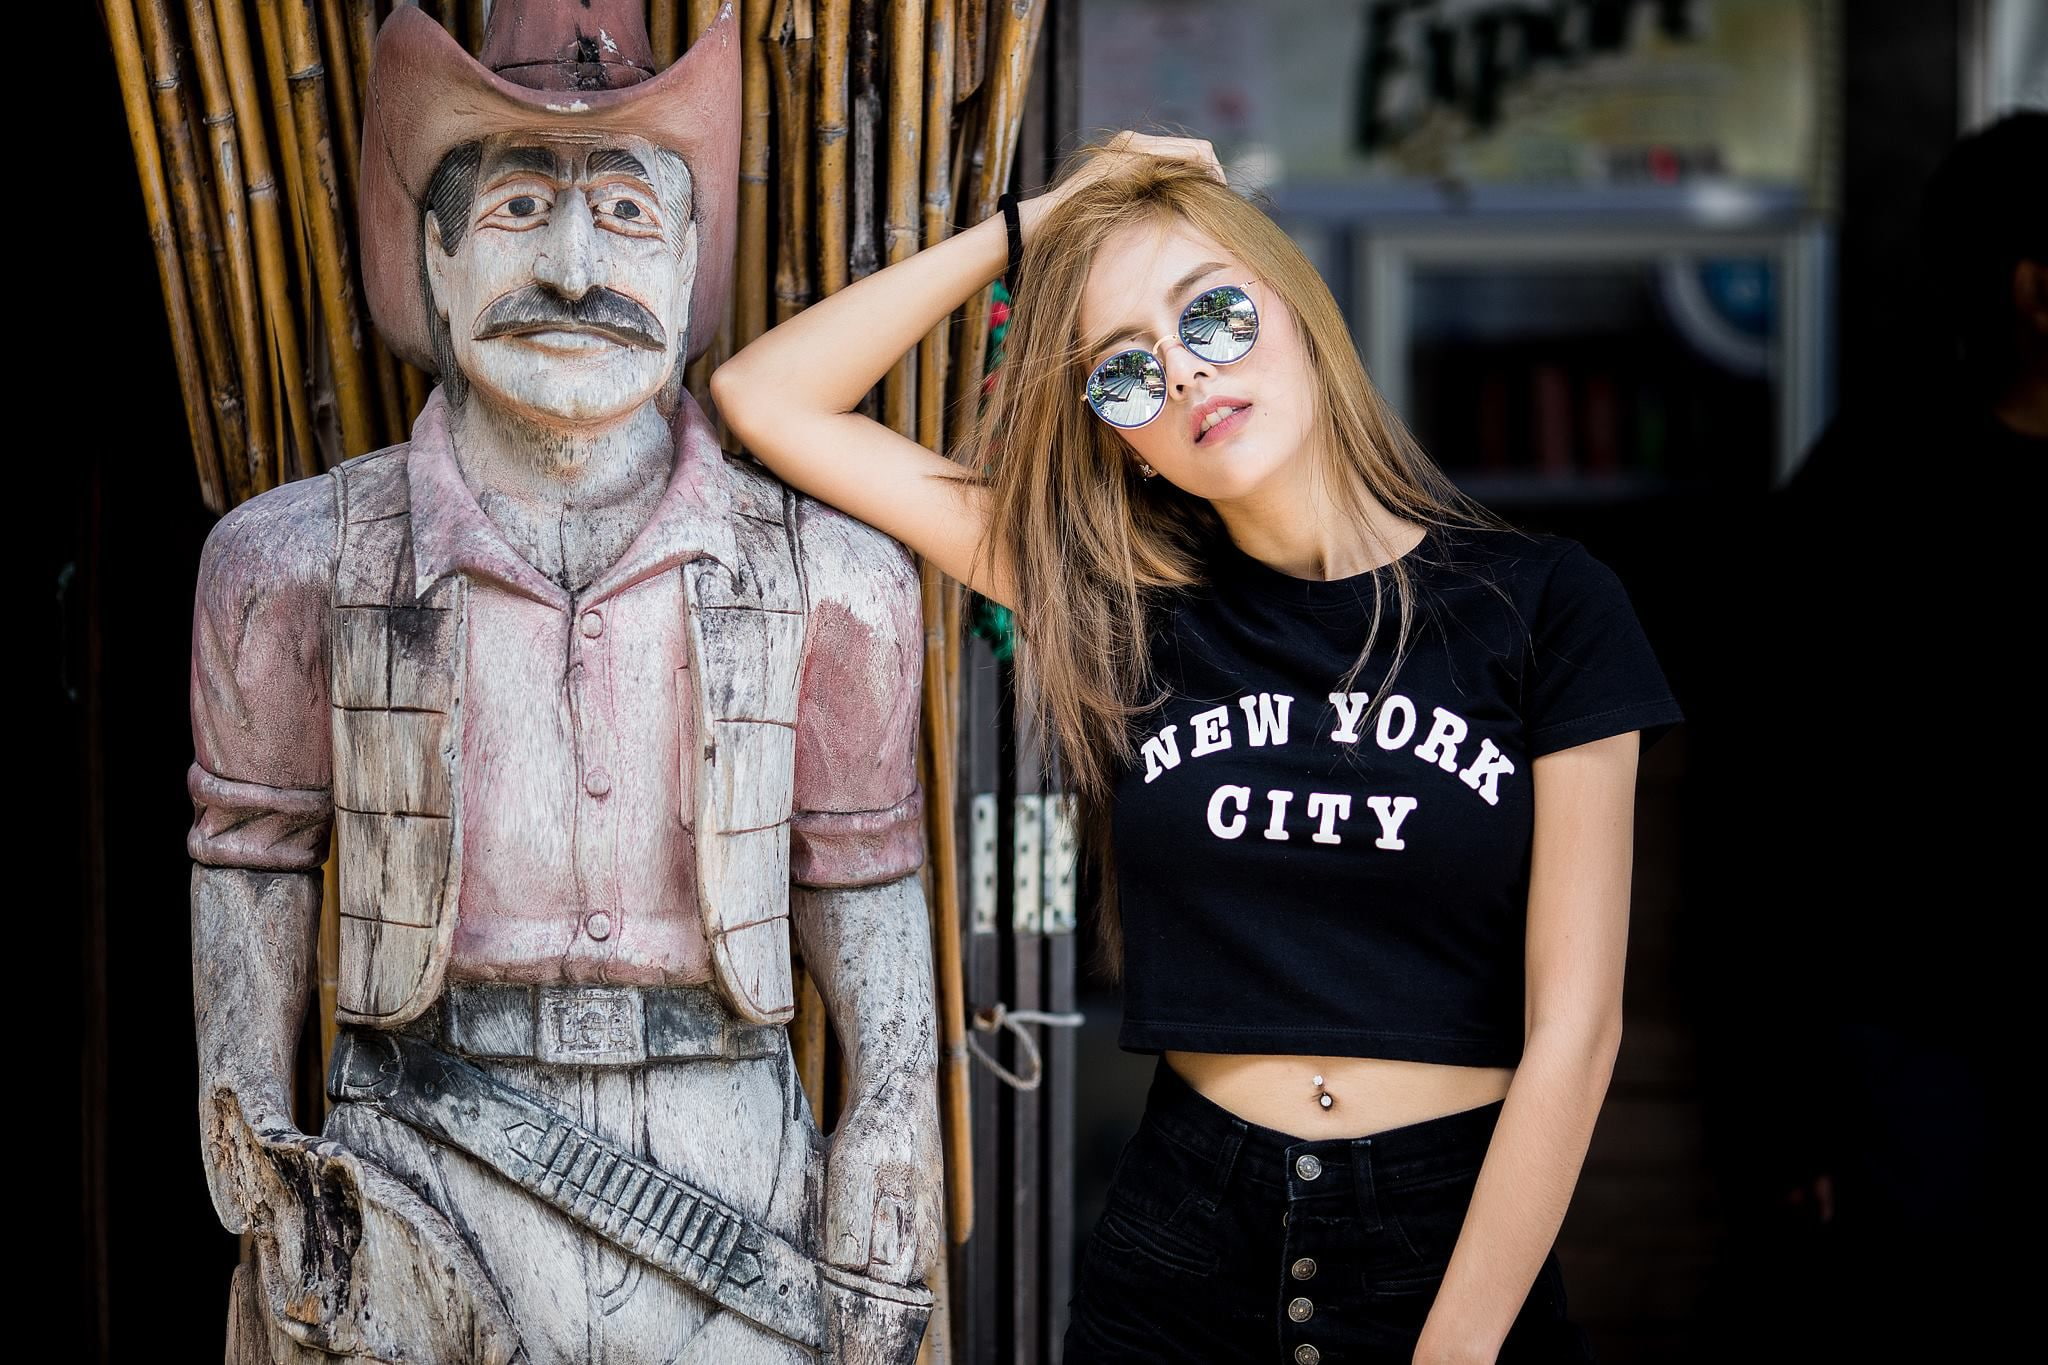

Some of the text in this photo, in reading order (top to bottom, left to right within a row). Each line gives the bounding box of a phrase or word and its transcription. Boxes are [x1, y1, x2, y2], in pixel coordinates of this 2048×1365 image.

[1139, 691, 1516, 806] NEW YORK
[1206, 783, 1419, 851] CITY
